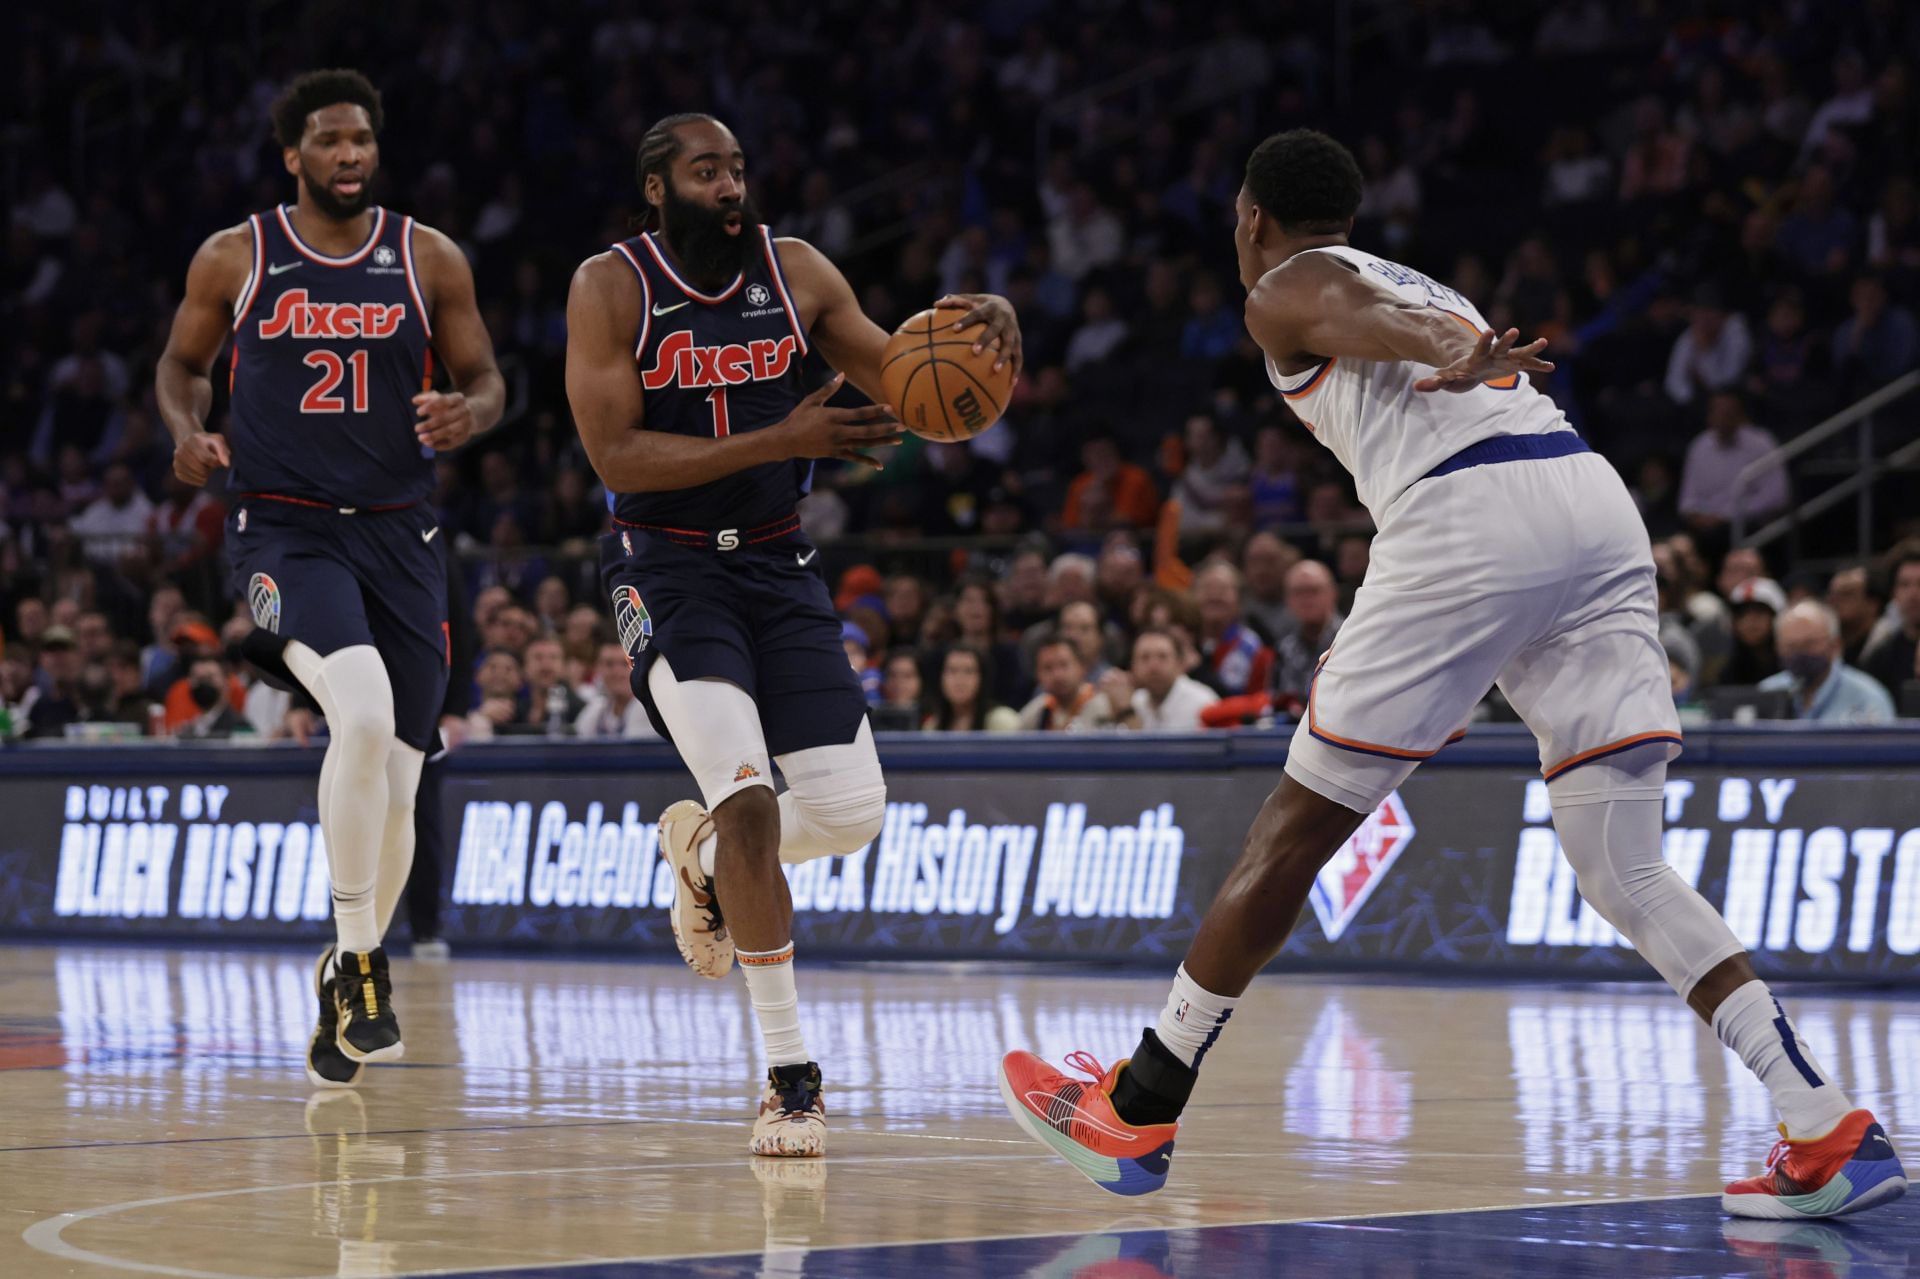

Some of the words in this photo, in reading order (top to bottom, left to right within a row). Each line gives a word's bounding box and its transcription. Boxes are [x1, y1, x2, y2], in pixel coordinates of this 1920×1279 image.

[259, 288, 405, 339] Sixers
[741, 307, 784, 318] crypto.com
[300, 349, 368, 413] 21
[641, 330, 796, 389] Sixers
[705, 387, 730, 438] 1
[64, 784, 169, 821] BUILT
[180, 784, 229, 821] BY
[1717, 778, 1796, 824] BY
[54, 821, 178, 919] BLACK
[177, 820, 332, 921] HISTOR
[452, 801, 532, 906] NBA
[529, 801, 675, 908] Celebr
[870, 802, 1038, 934] History
[1032, 802, 1184, 919] Month
